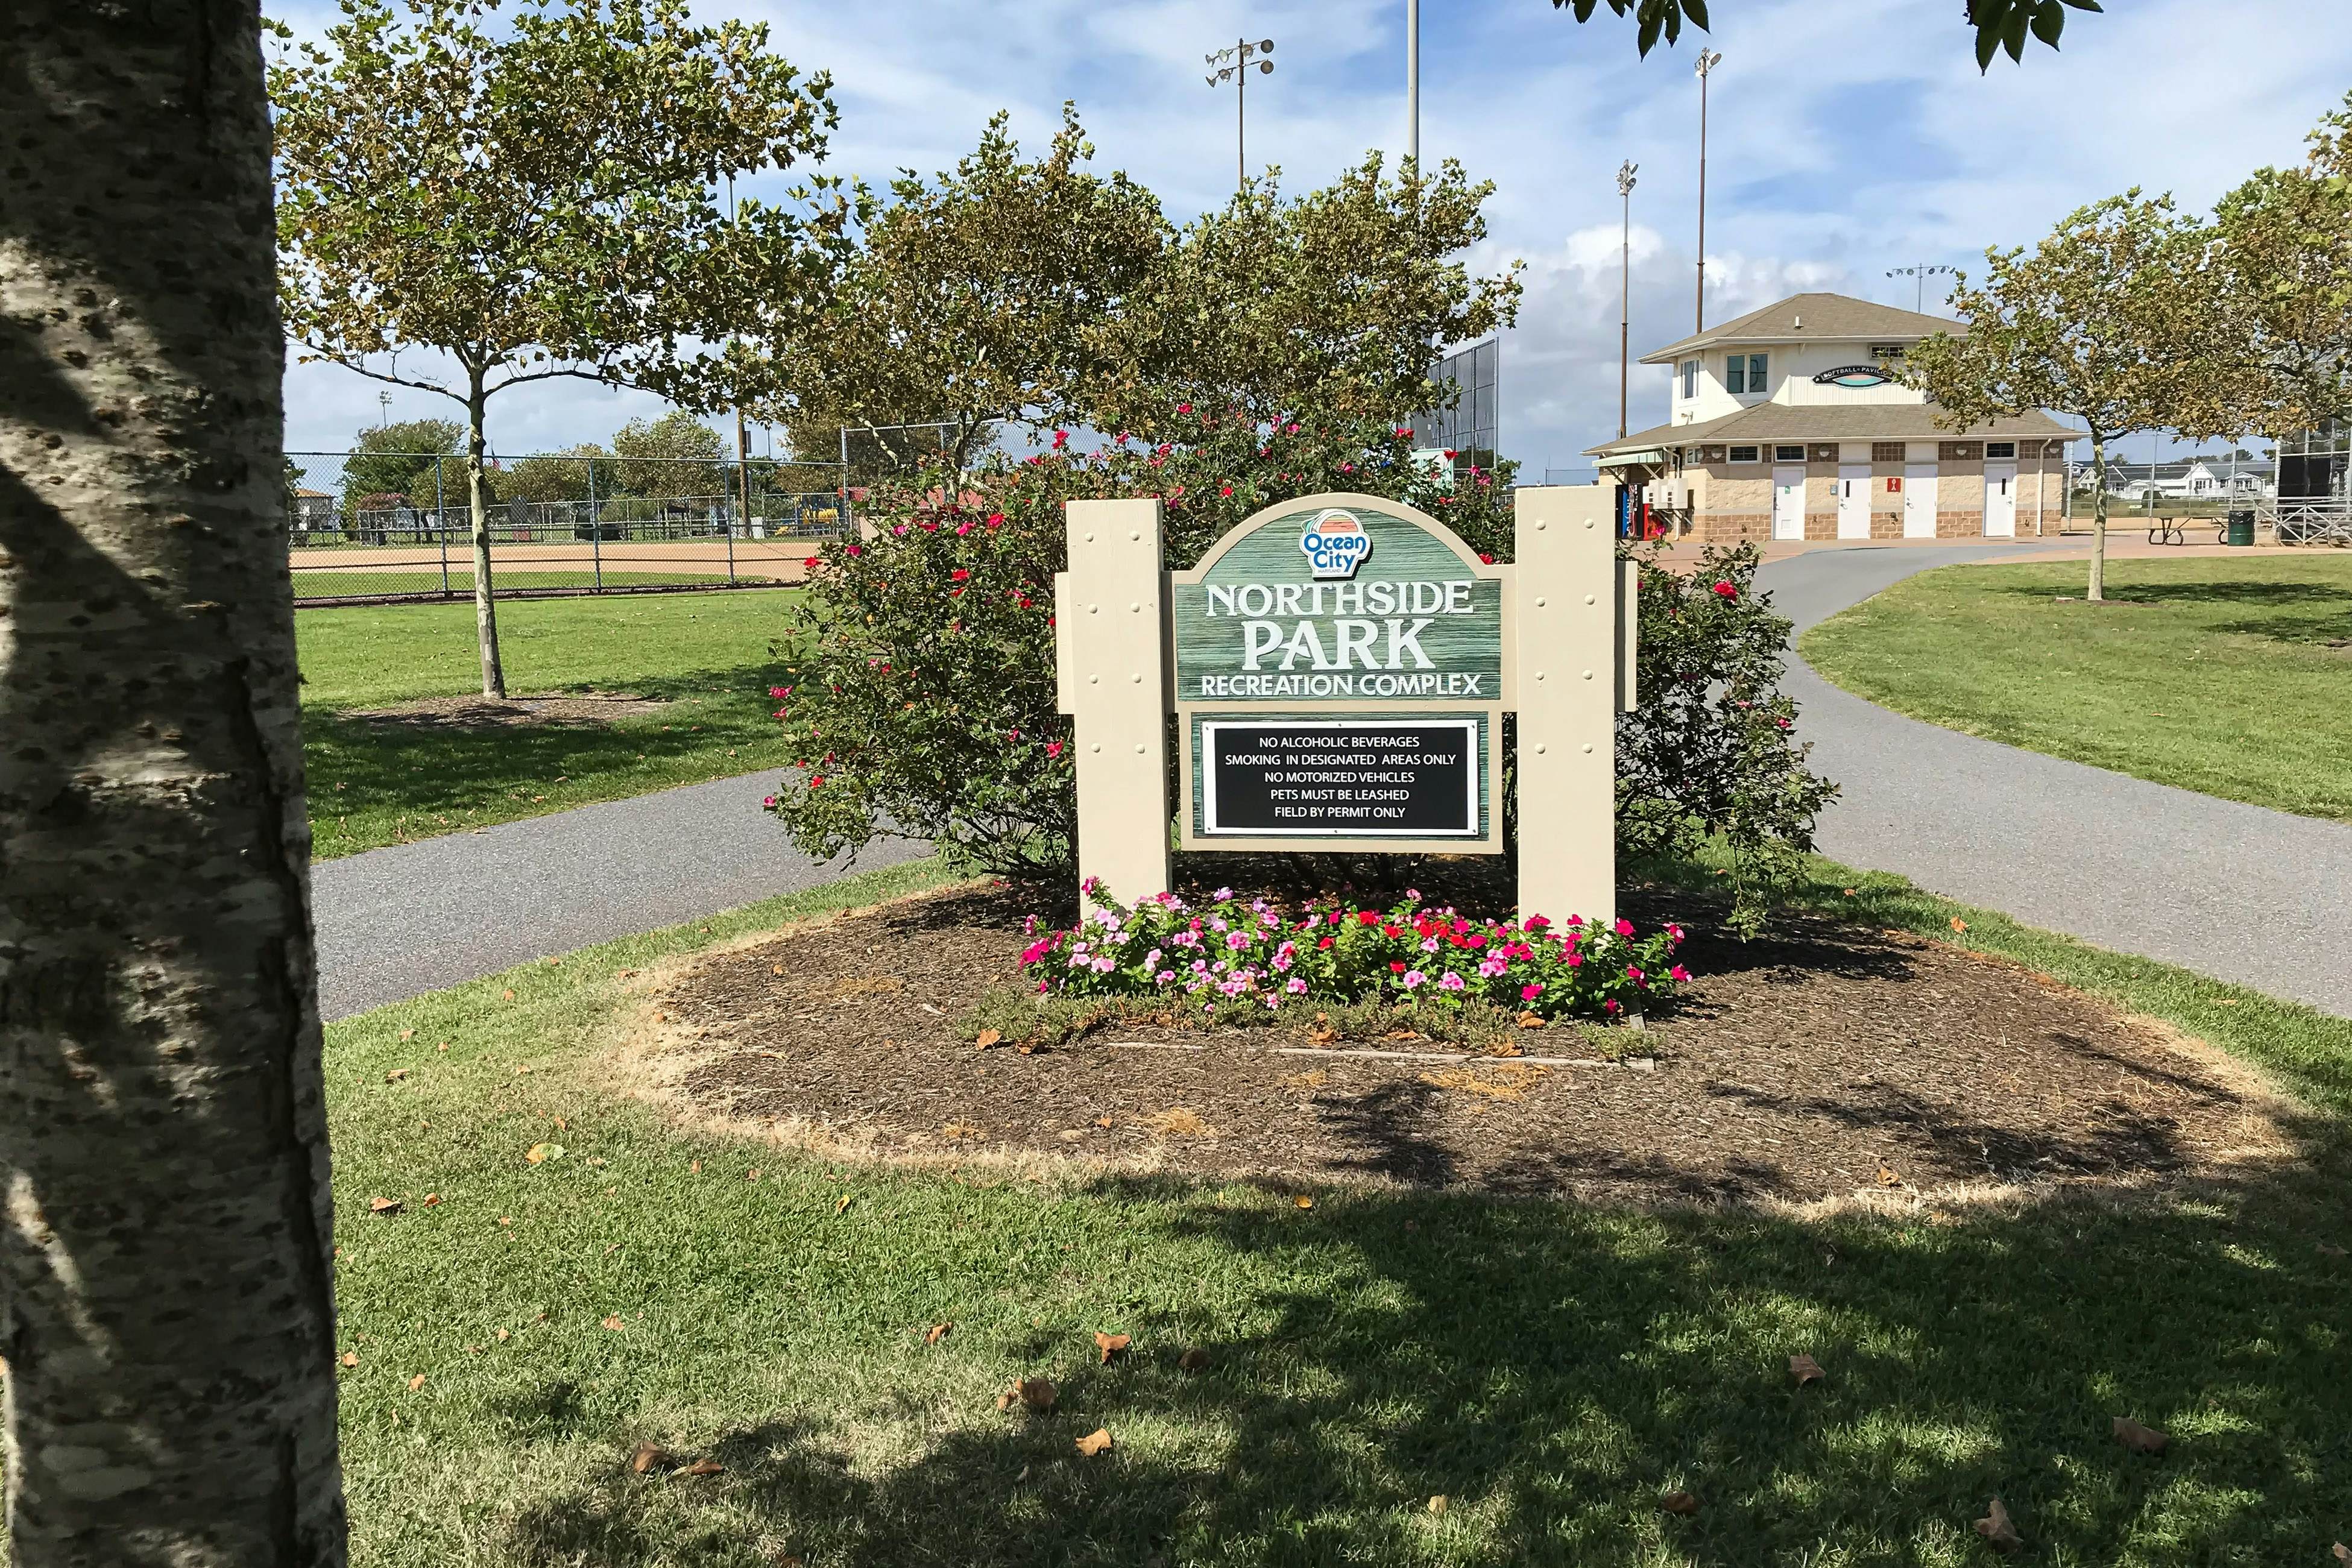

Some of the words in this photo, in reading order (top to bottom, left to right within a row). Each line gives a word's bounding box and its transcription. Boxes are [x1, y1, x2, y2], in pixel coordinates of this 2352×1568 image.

[1823, 367, 1857, 378] SOFTBALL
[1861, 367, 1893, 376] PAVILIO
[1304, 534, 1366, 554] Ocean
[1314, 550, 1355, 573] City
[1205, 581, 1474, 617] NORTHSIDE
[1241, 619, 1437, 671] PARK
[1201, 674, 1353, 696] RECREATION
[1359, 673, 1482, 696] COMPLEX
[1259, 737, 1278, 748] NO
[1280, 737, 1349, 748] ALCOHOLIC
[1352, 736, 1420, 748] BEVERAGES
[1225, 754, 1281, 765] SMOKING
[1286, 755, 1299, 765] IN
[1301, 754, 1376, 765] DESIGNATED
[1381, 754, 1421, 765] AREAS
[1423, 754, 1457, 765] ONLY
[1264, 772, 1284, 782] NO
[1286, 772, 1357, 782] MOTORIZED
[1358, 772, 1415, 782] VEHICLES
[1270, 789, 1299, 800] PETS
[1301, 789, 1335, 800] MUST
[1337, 789, 1352, 800] BE
[1355, 789, 1410, 801] LEASHED
[1275, 807, 1307, 817] FIELD
[1310, 807, 1325, 817] BY
[1328, 807, 1372, 817] PERMIT
[1373, 807, 1405, 818] ONLY
